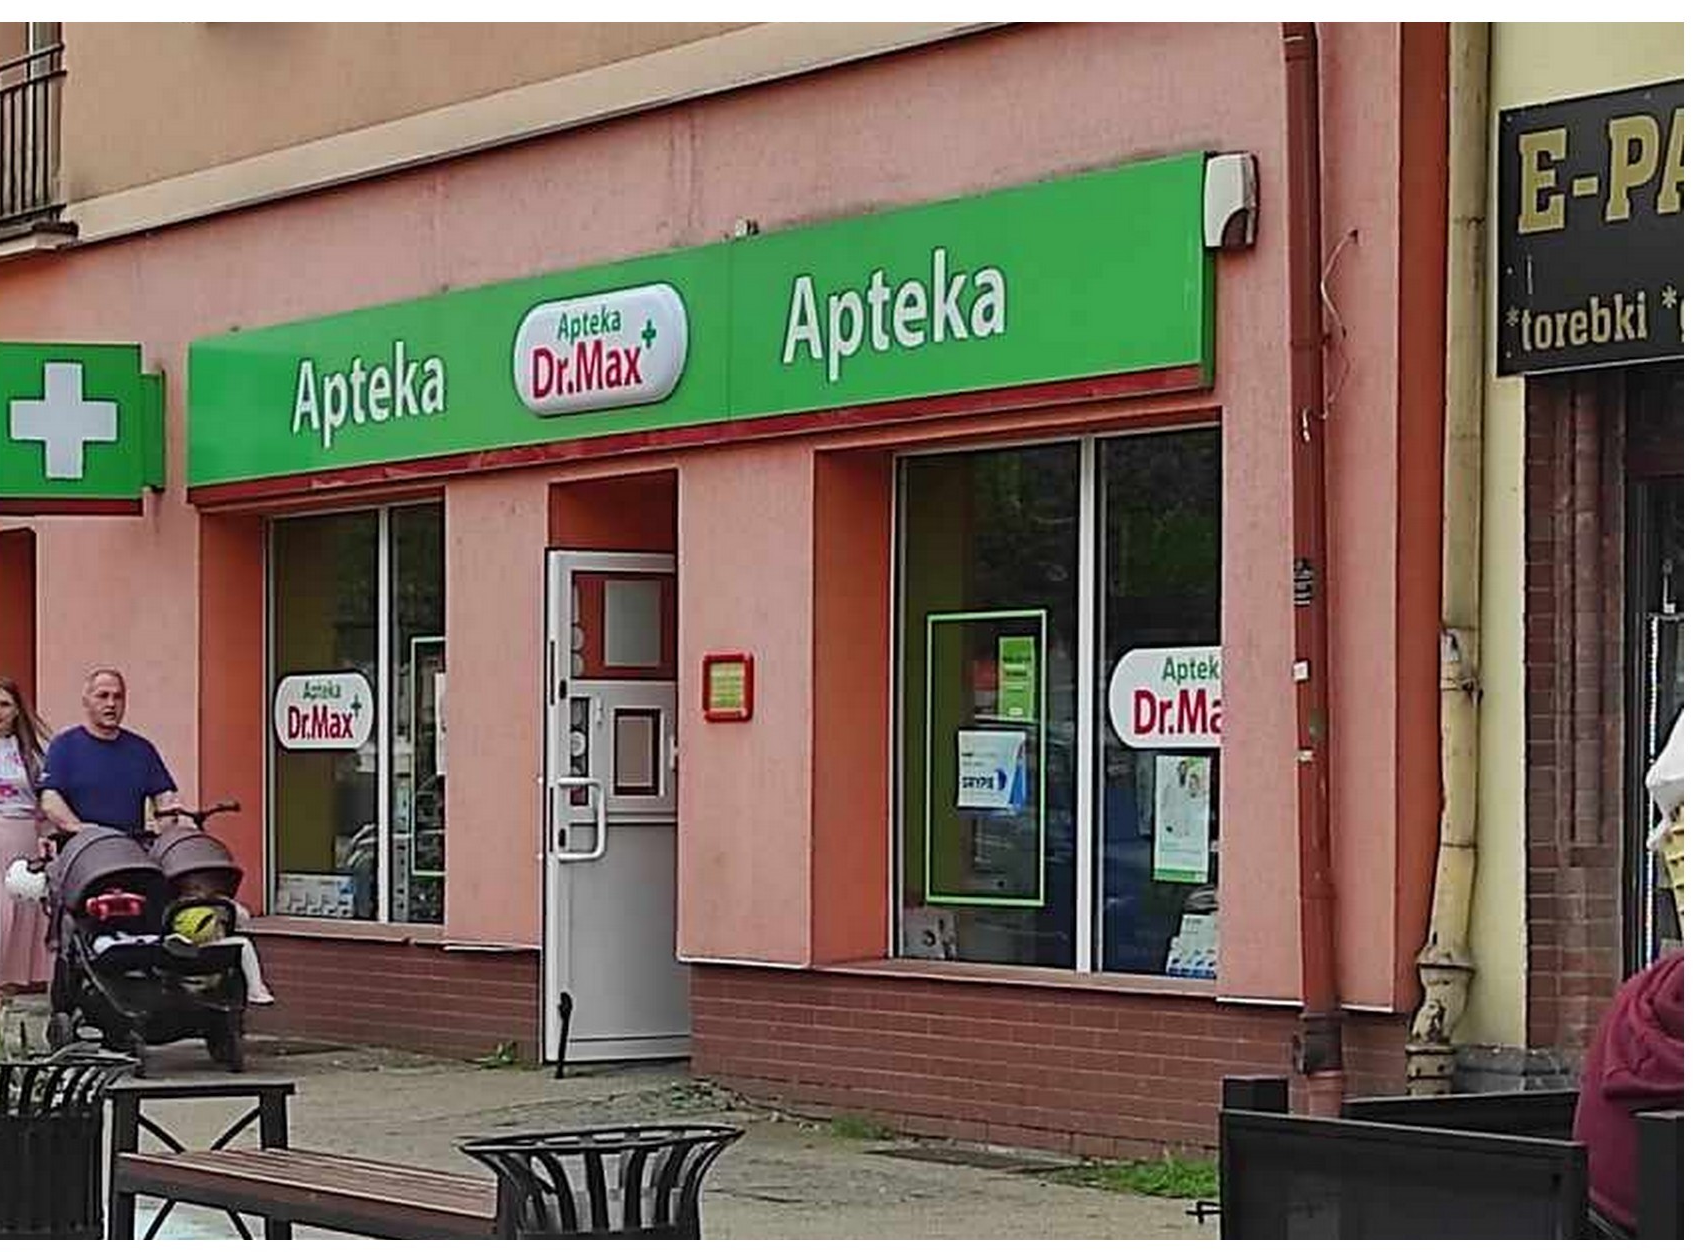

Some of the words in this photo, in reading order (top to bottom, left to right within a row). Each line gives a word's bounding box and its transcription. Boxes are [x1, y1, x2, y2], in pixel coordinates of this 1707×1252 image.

[558, 305, 621, 344] Apteka
[783, 249, 1005, 381] Apteka
[1521, 292, 1648, 351] torebki
[293, 341, 444, 448] Apteka
[532, 340, 642, 398] Dr.Max
[288, 704, 353, 739] Dr.Max
